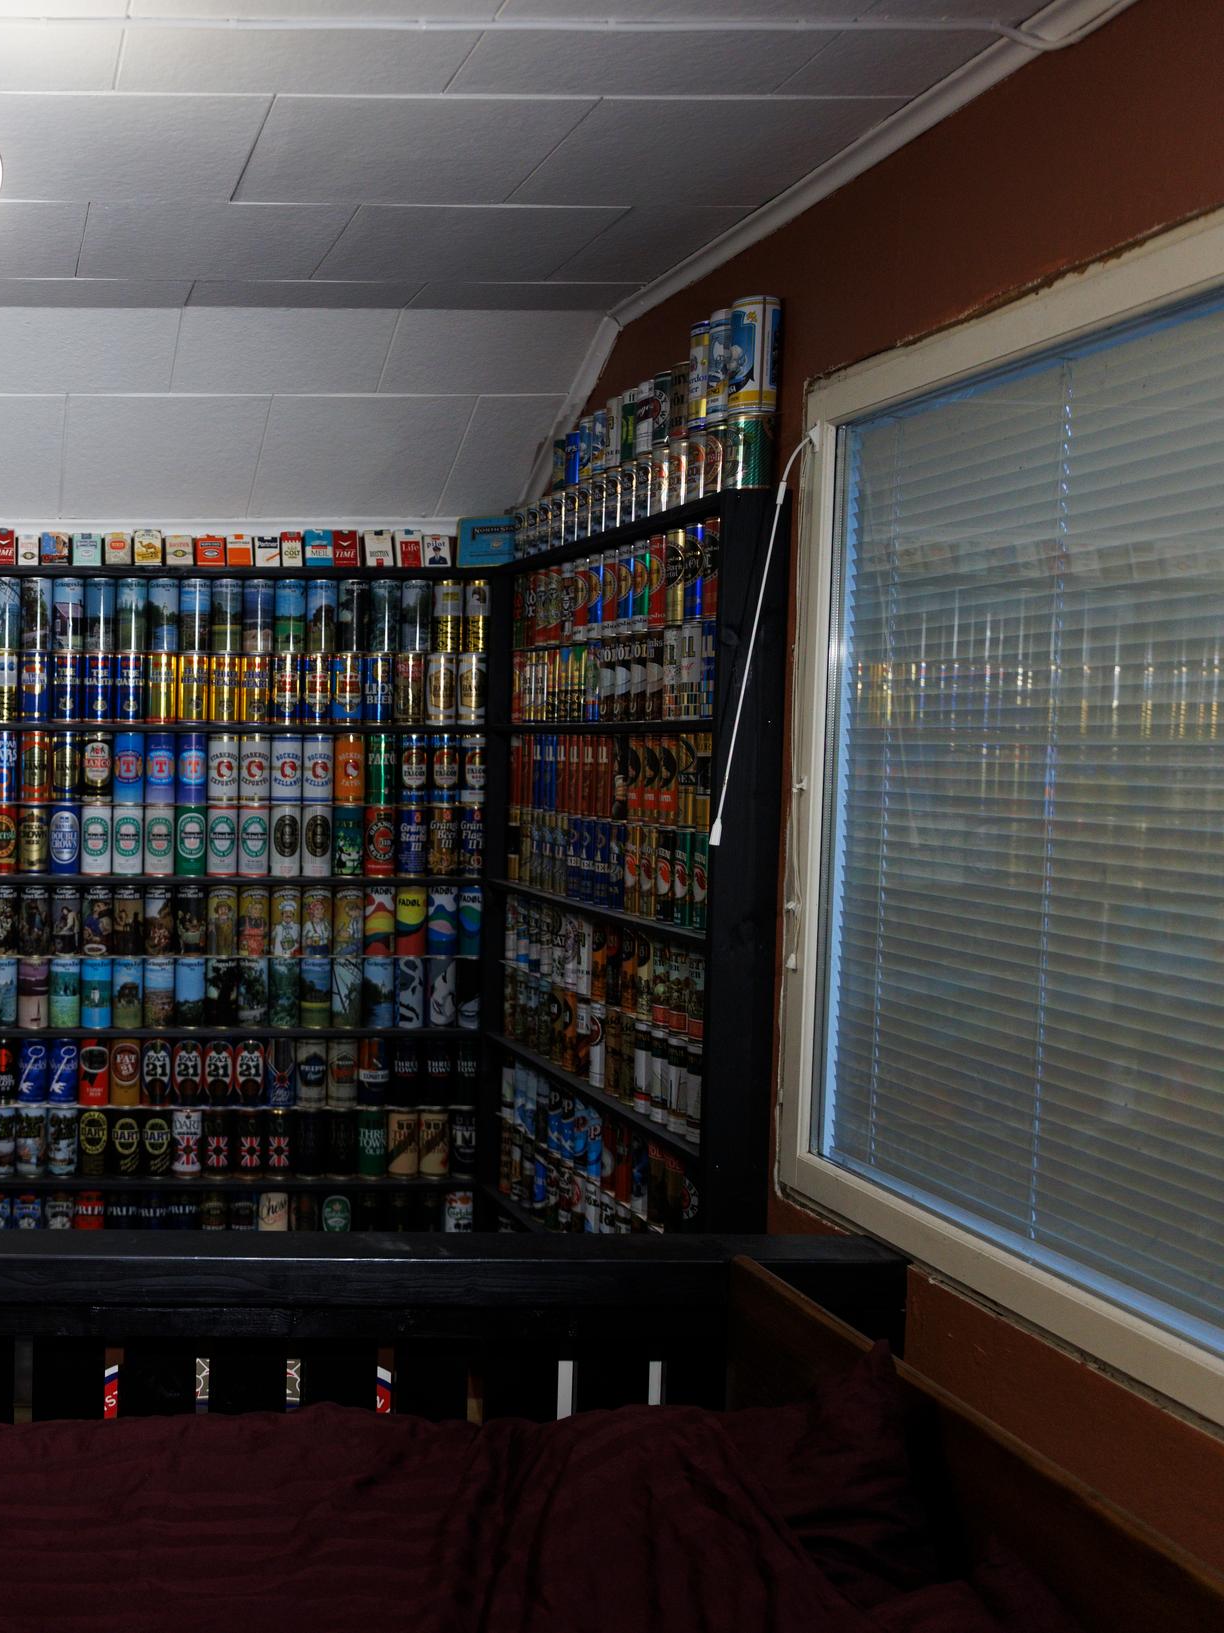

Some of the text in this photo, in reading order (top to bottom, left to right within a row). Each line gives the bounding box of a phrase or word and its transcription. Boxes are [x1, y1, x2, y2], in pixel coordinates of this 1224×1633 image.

[402, 543, 420, 551] Life
[427, 541, 446, 549] pilot
[365, 683, 394, 694] LION
[83, 758, 111, 769] BANCO
[122, 761, 133, 773] T
[156, 761, 168, 773] T
[188, 761, 200, 773] T
[431, 887, 454, 895] FADØL
[398, 899, 421, 907] FADØL
[146, 1064, 168, 1077] 21
[177, 1063, 200, 1077] 21
[208, 1064, 229, 1077] 21
[239, 1063, 261, 1077] 21
[81, 1126, 105, 1138] DART
[142, 1130, 171, 1141] DART
